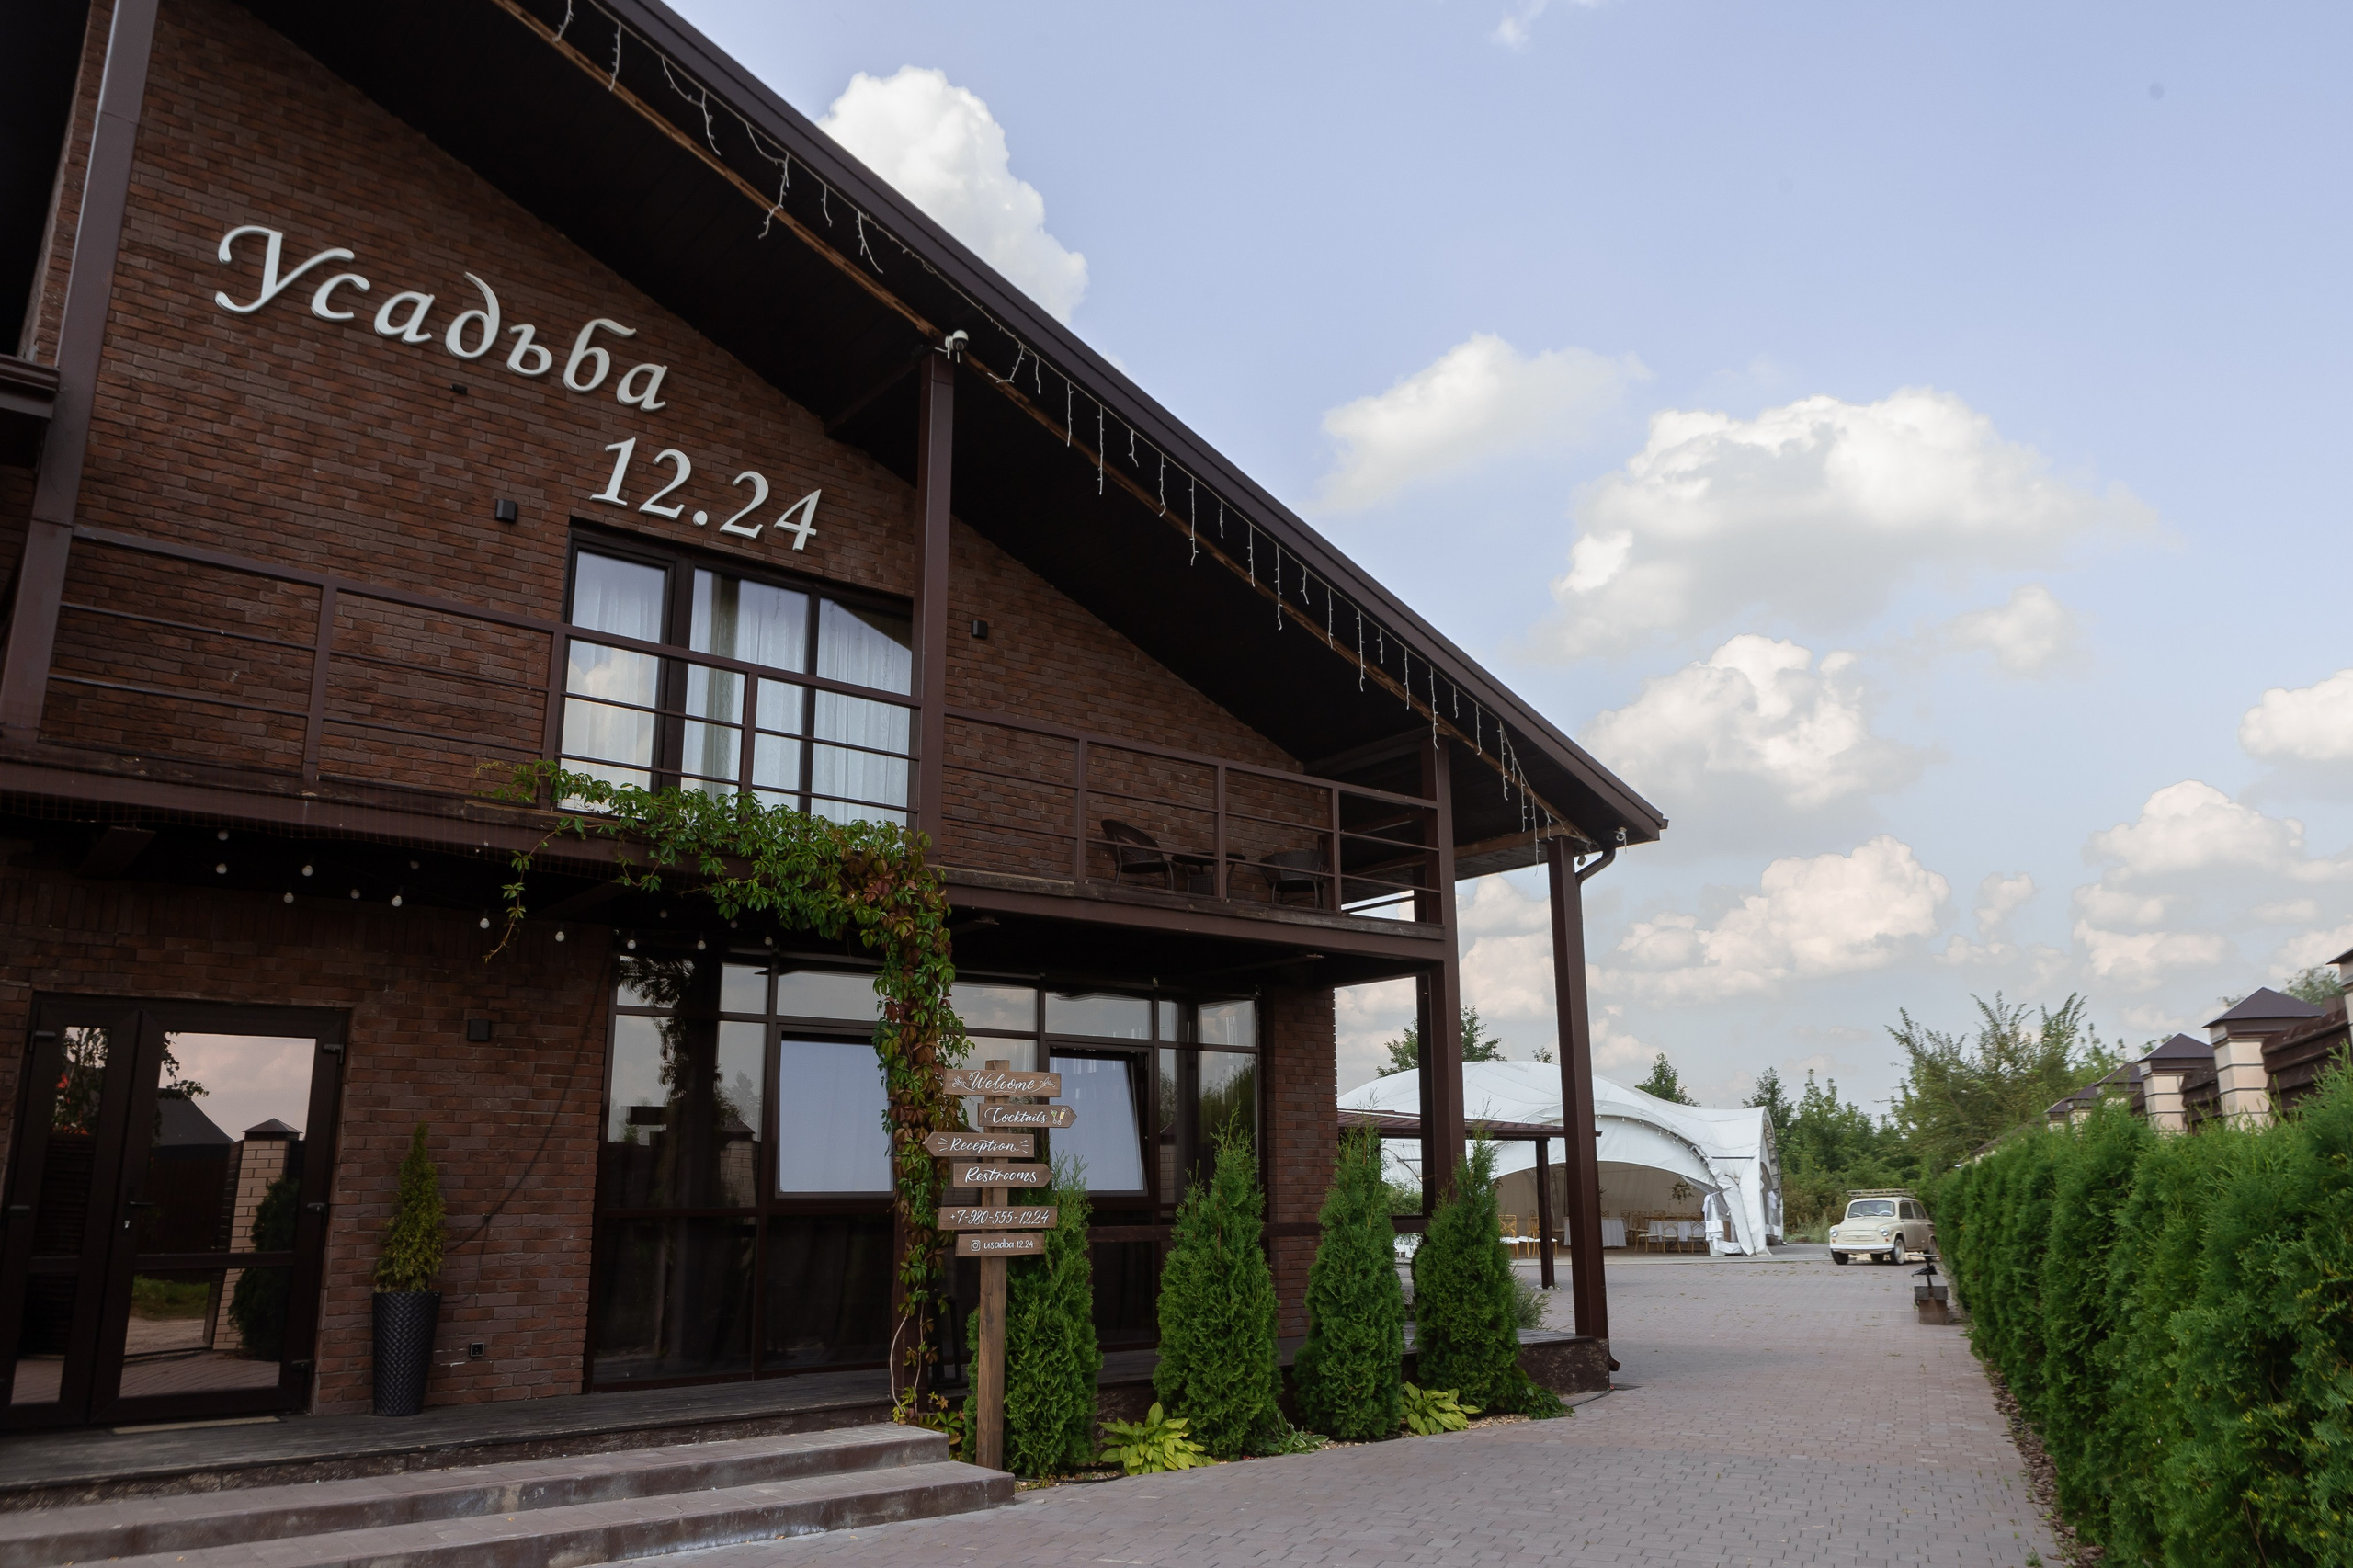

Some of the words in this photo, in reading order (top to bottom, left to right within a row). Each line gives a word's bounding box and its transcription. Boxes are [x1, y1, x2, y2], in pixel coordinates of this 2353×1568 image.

[214, 224, 668, 411] Усадьба
[589, 437, 822, 551] 12.24
[968, 1070, 1036, 1093] Welcome
[984, 1106, 1048, 1124] Cocktails
[950, 1137, 1019, 1154] Reception
[965, 1166, 1037, 1184] Restrooms
[950, 1210, 1050, 1225] +7-980-555-1224
[983, 1238, 1015, 1250] usadba
[1016, 1240, 1034, 1249] 12.24
